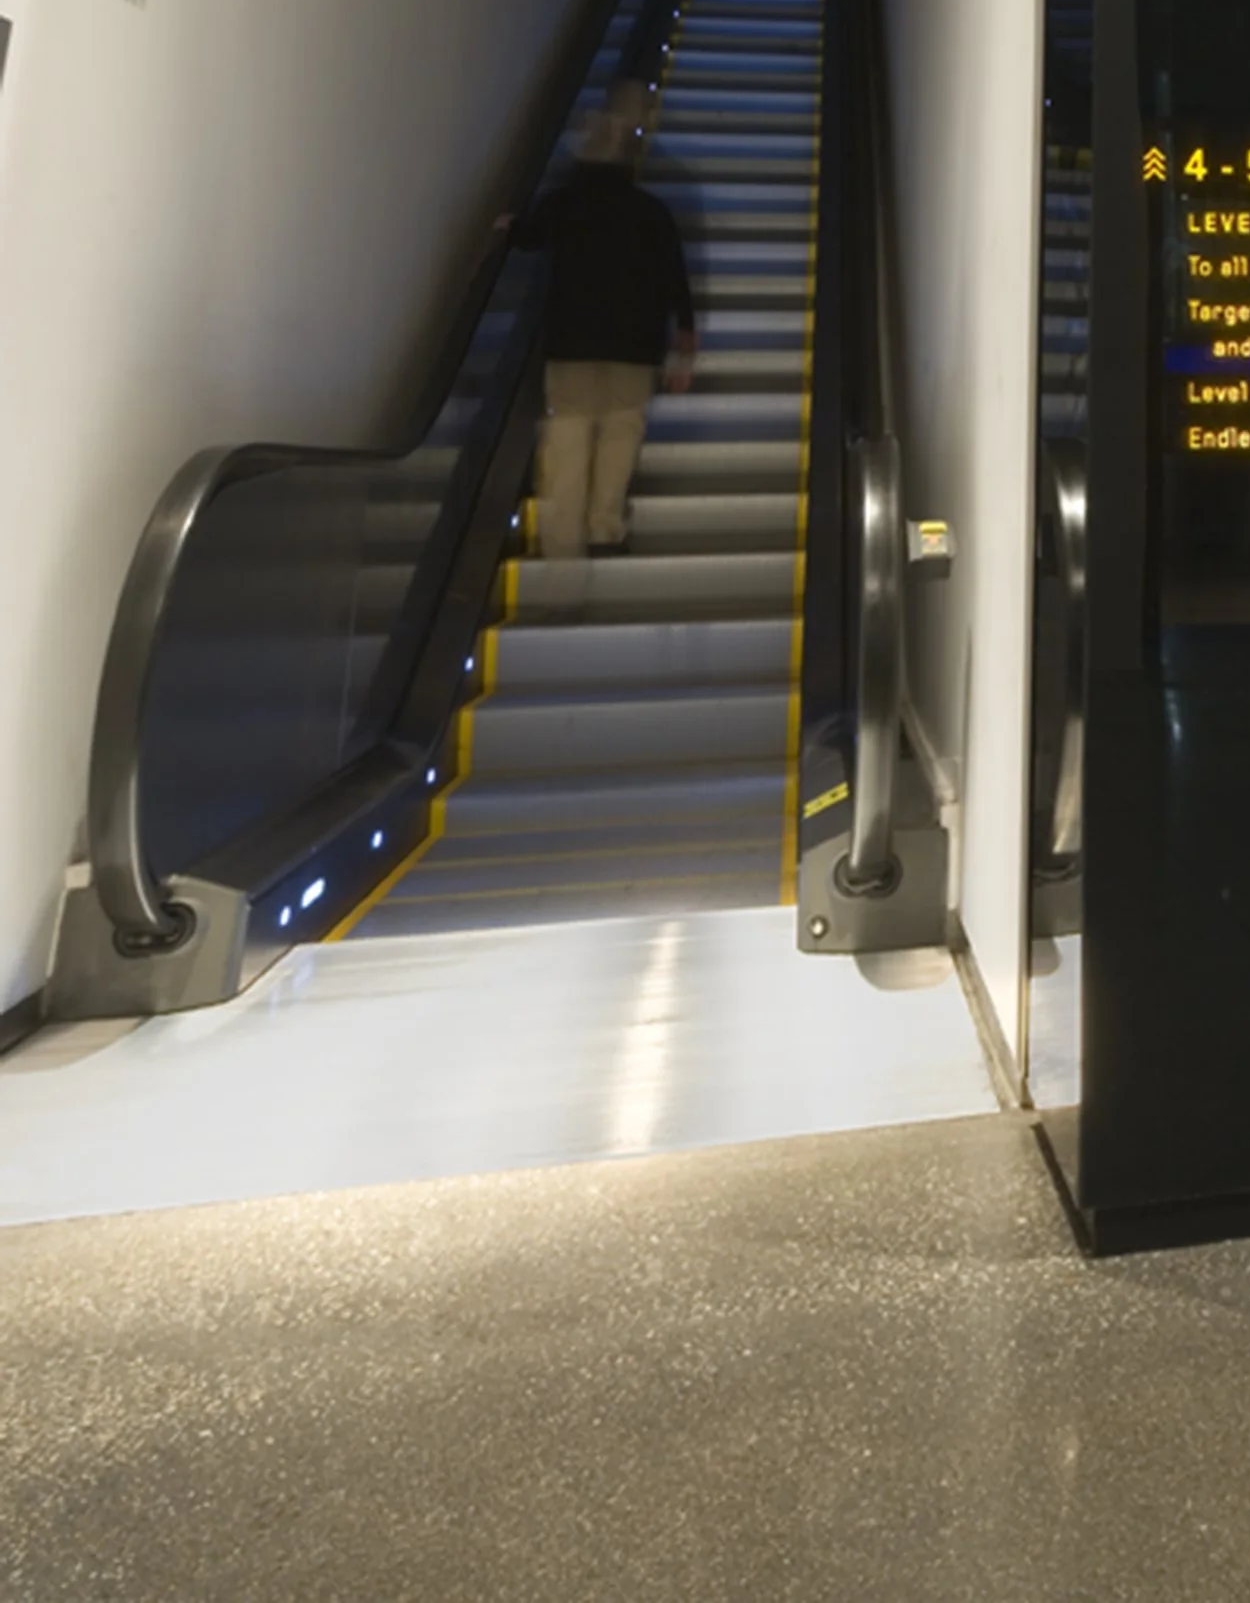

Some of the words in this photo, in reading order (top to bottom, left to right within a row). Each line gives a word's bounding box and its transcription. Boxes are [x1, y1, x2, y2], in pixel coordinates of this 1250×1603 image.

[1184, 148, 1207, 181] 4
[1189, 256, 1213, 276] To
[1220, 256, 1248, 277] all
[1189, 381, 1248, 403] Level
